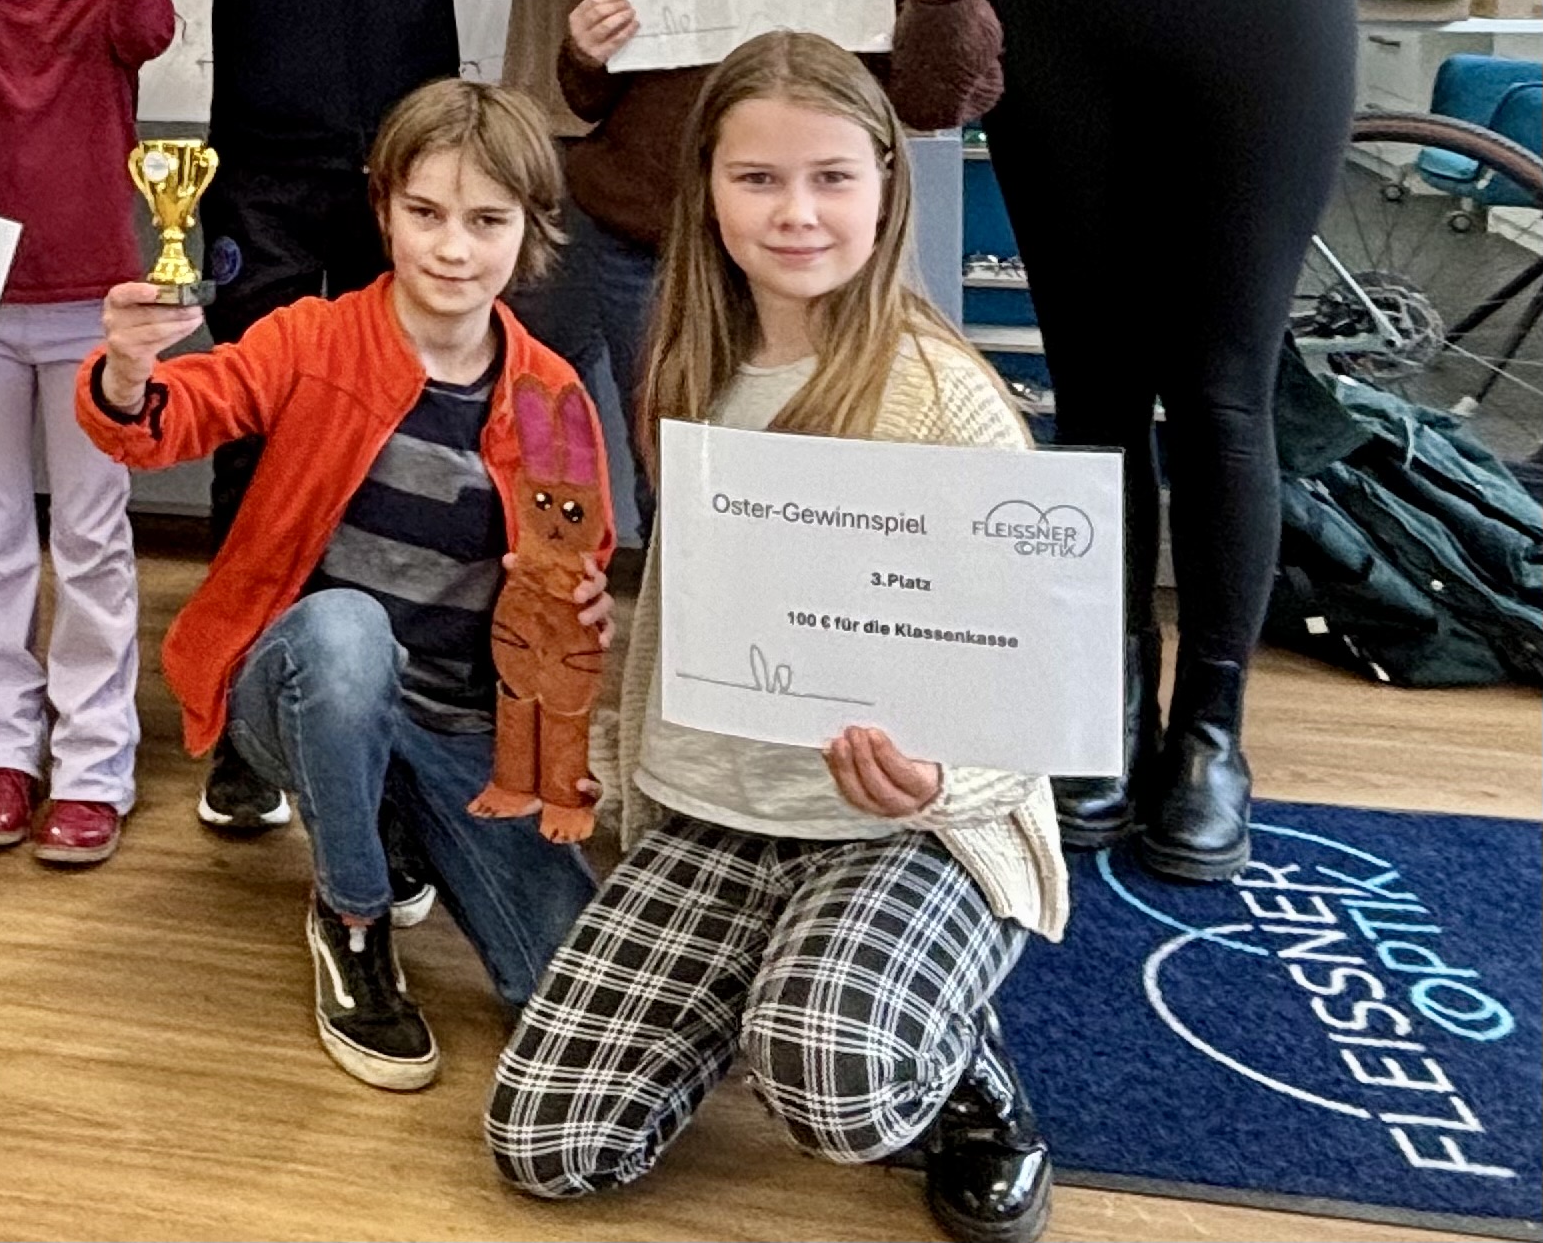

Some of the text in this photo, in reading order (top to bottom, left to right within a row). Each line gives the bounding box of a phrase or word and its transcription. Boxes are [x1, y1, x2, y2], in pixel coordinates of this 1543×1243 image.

[711, 492, 928, 536] Oster-Gewinnspiel
[971, 519, 1078, 548] FLEISSNER
[1013, 540, 1079, 558] OPTIK
[869, 571, 933, 592] 3.Platz
[787, 610, 1020, 649] 100 € für die Klassenkasse
[1315, 864, 1516, 1042] OPTIK
[1232, 860, 1518, 1179] FLEISSNER
